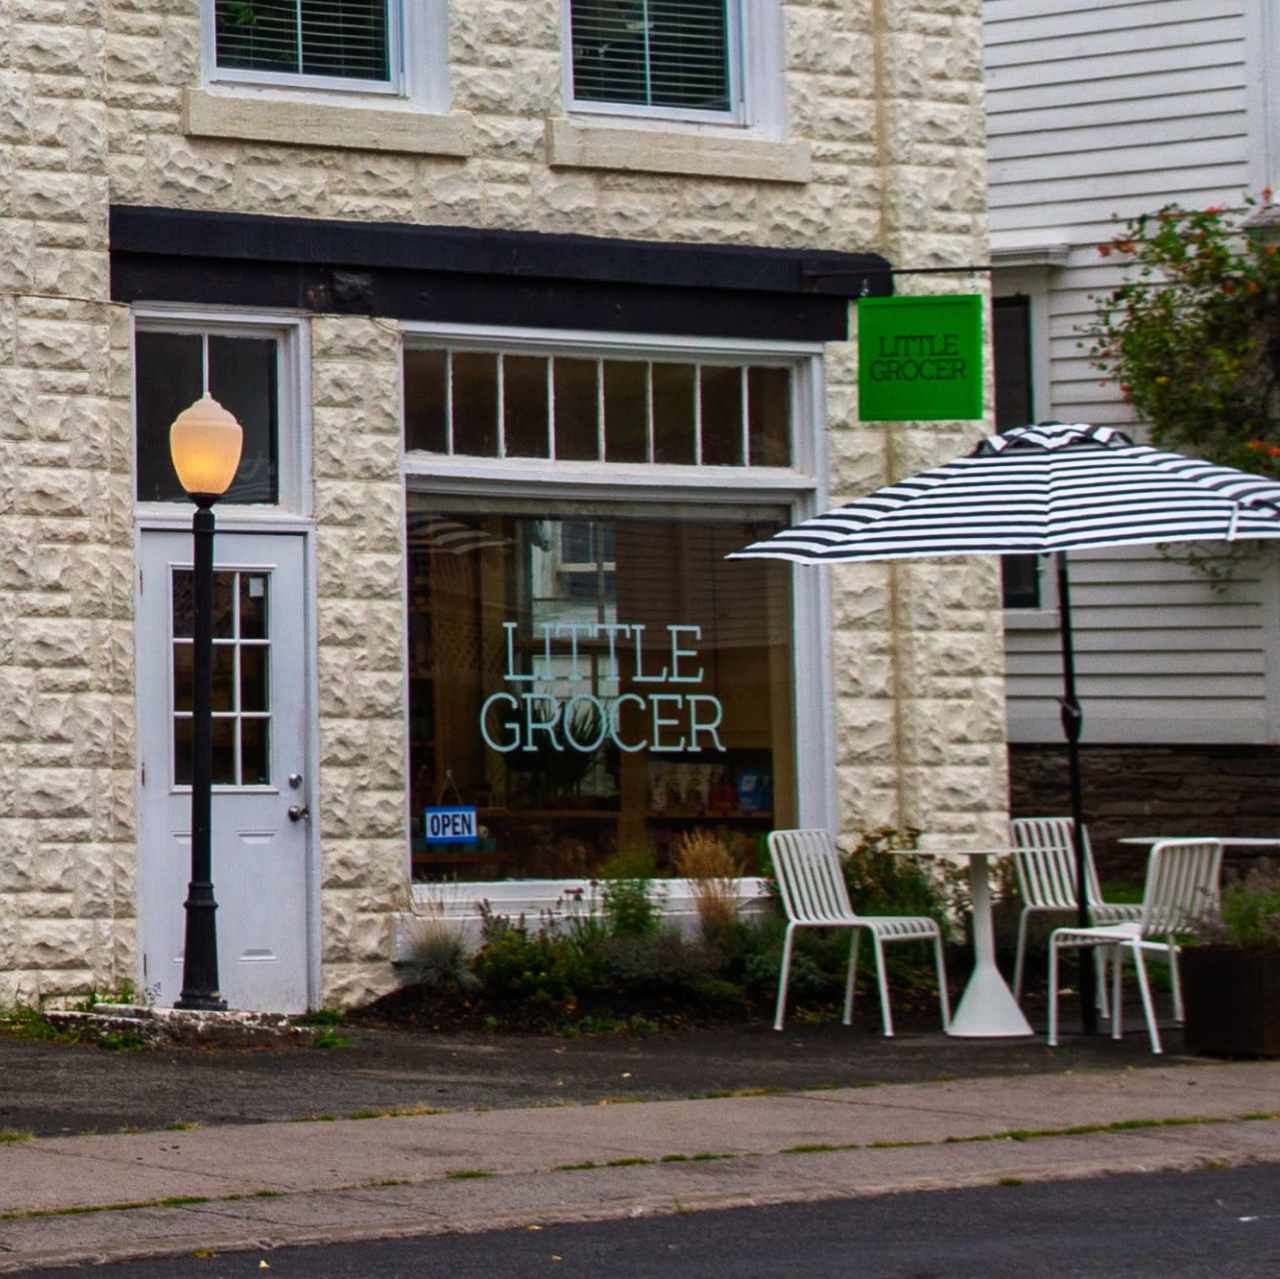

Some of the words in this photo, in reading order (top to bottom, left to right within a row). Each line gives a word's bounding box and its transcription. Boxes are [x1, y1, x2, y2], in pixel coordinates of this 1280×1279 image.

[879, 333, 960, 357] LITTLE
[870, 358, 967, 382] GROCER
[501, 621, 705, 684] LITTLE
[479, 692, 727, 754] GROCER
[430, 813, 473, 837] OPEN
